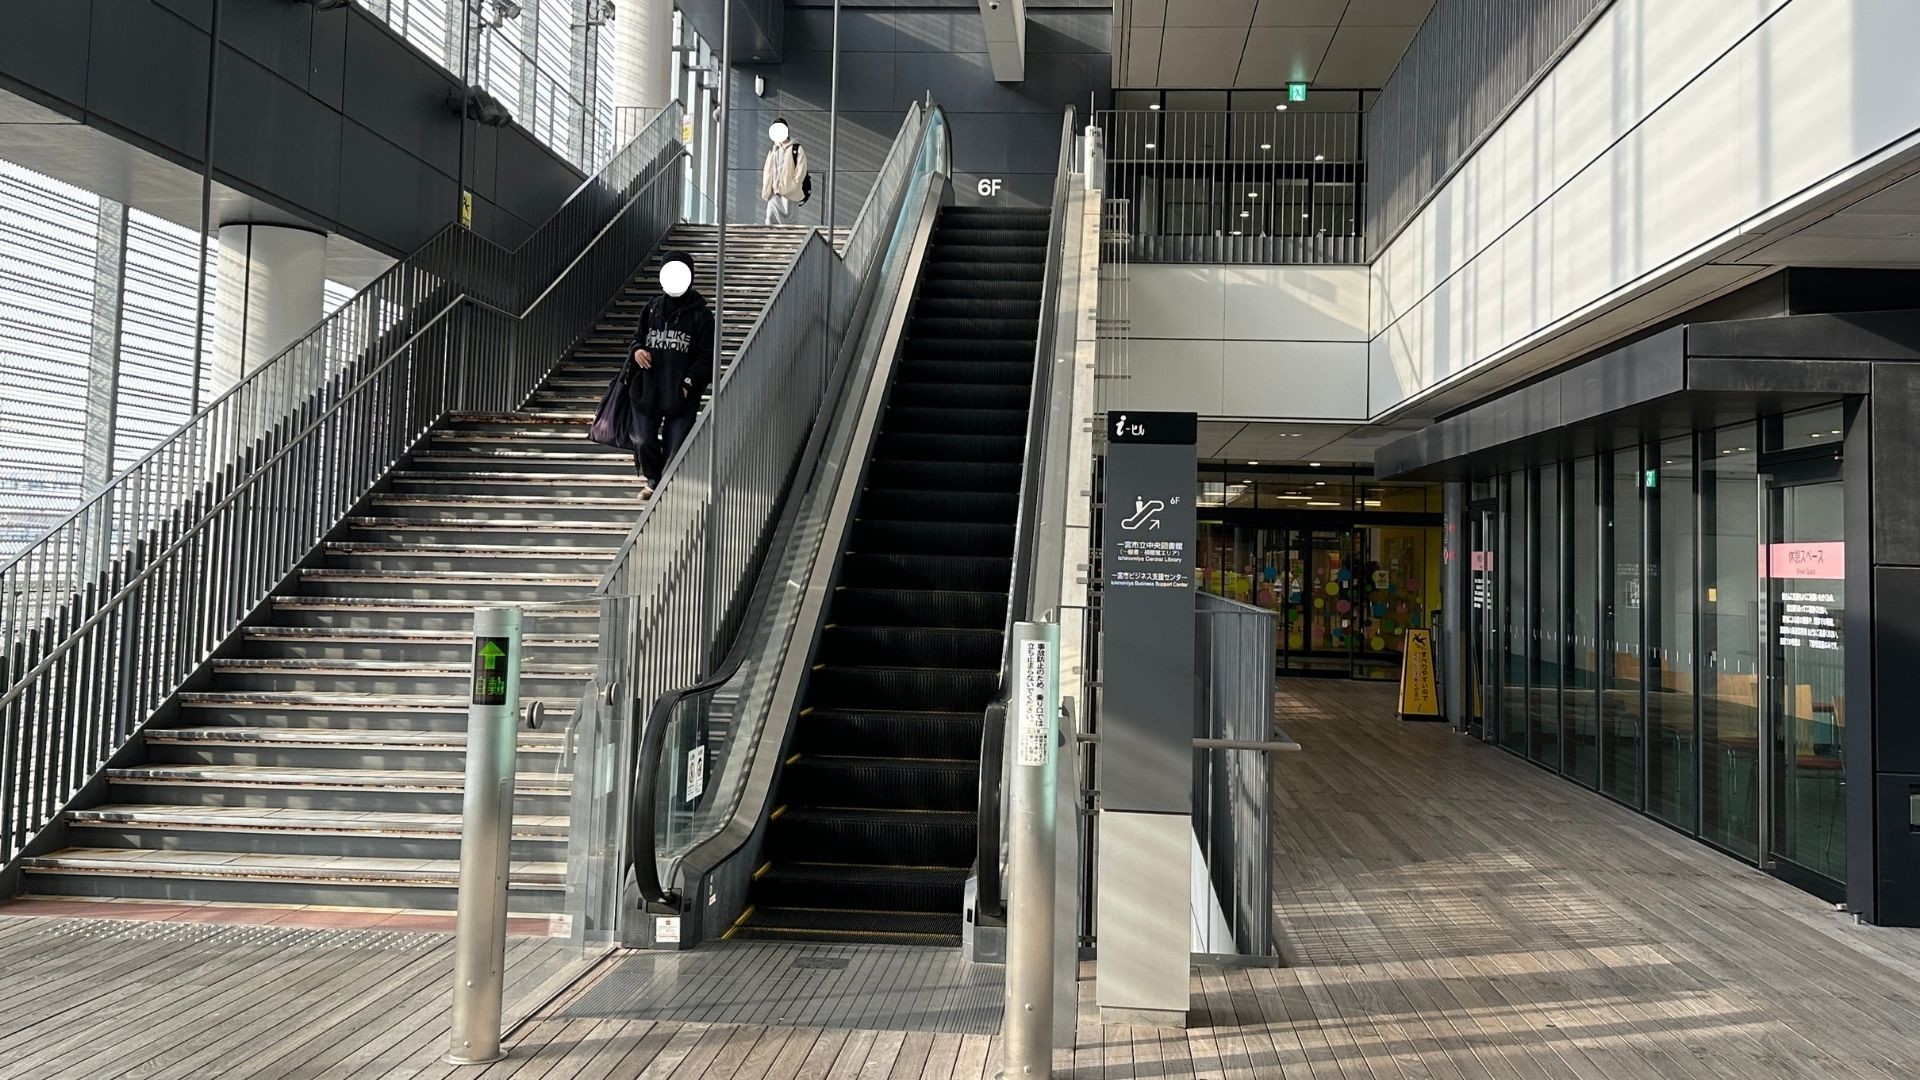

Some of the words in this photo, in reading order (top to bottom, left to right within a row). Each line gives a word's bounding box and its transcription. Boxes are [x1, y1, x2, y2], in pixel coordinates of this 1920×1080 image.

[978, 179, 1002, 196] 6F
[667, 330, 691, 343] LIKE
[656, 340, 690, 353] KNOW
[1170, 496, 1181, 505] 6F
[1117, 541, 1183, 550] 一宮市立中央図書館
[1111, 572, 1188, 580] 一宮市ビジネス支援センター
[475, 675, 505, 696] 自動
